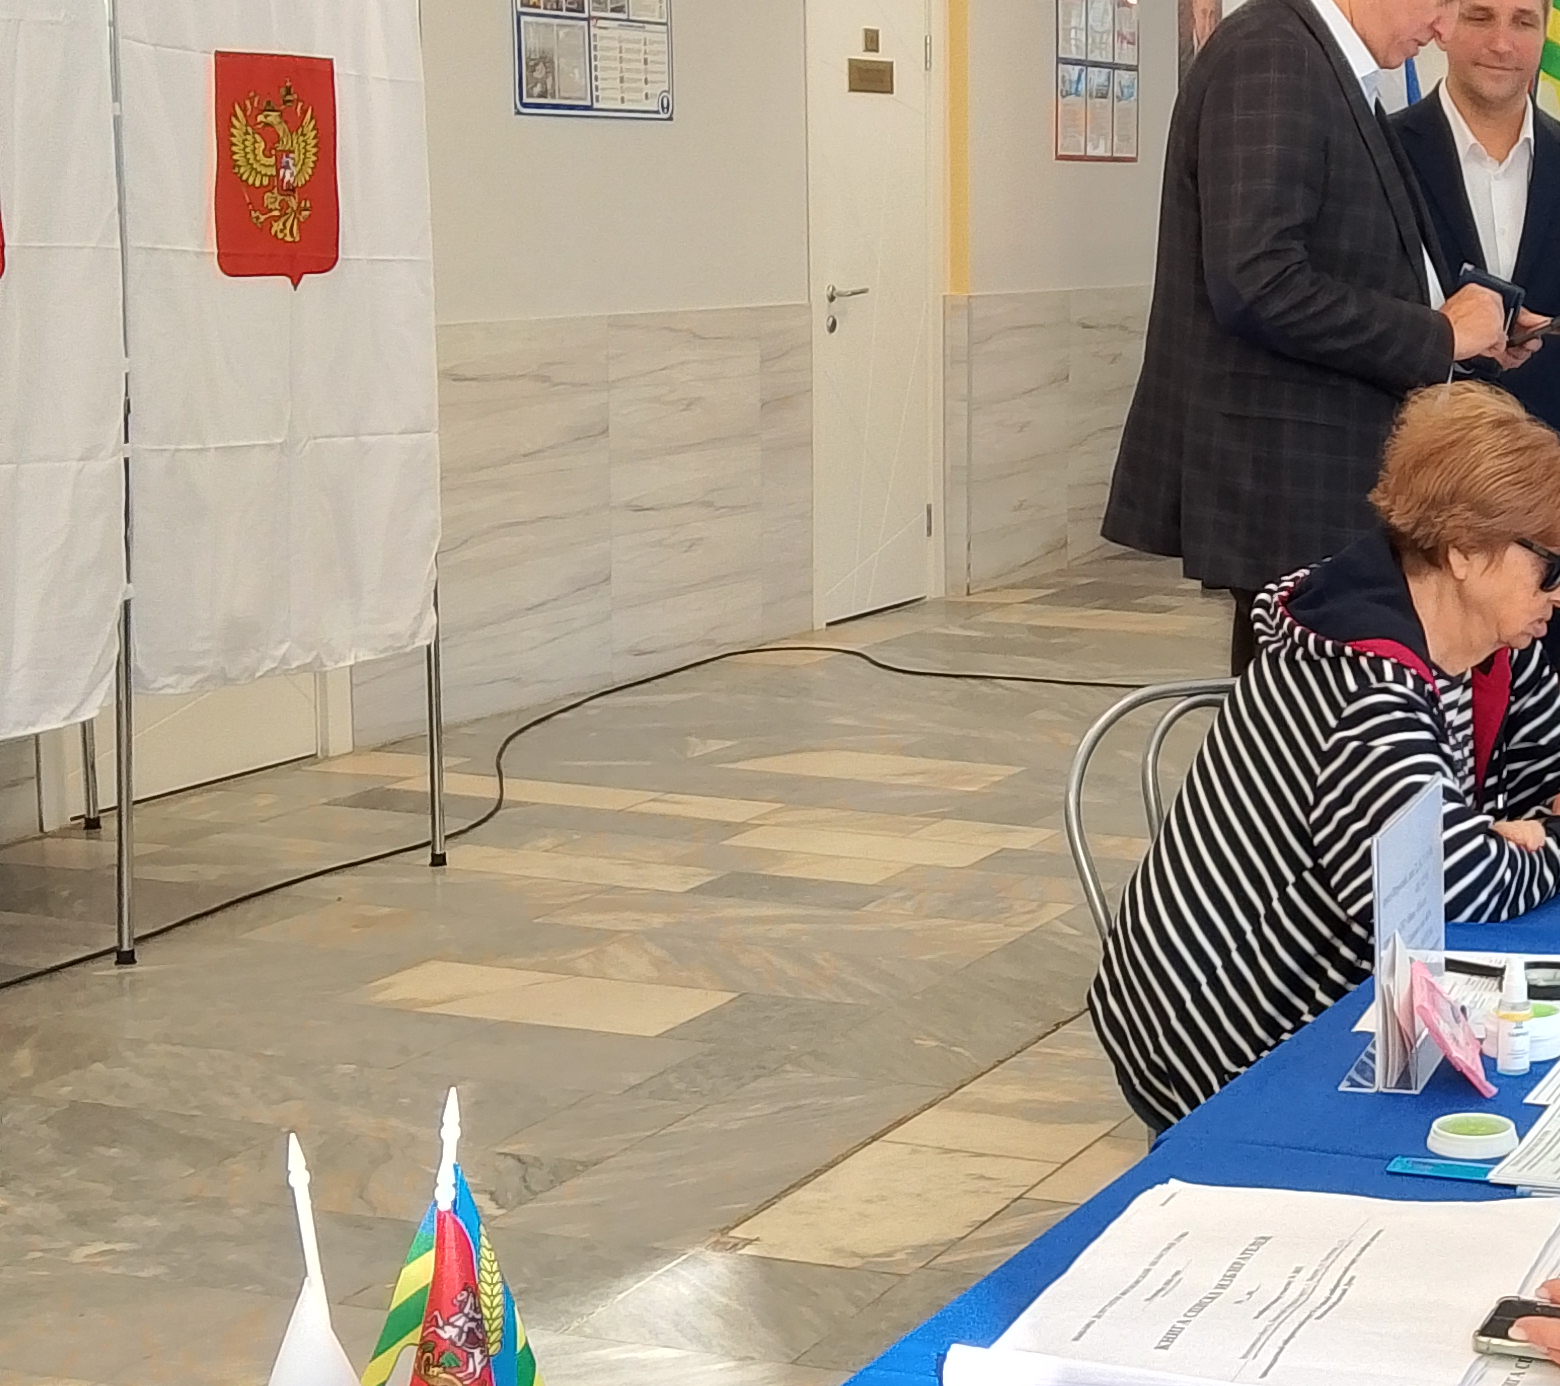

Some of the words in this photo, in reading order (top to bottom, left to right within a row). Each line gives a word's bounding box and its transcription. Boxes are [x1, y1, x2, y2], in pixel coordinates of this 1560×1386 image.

[1153, 1319, 1192, 1350] КНИГА
[1183, 1291, 1224, 1318] СПИСКА
[1214, 1235, 1275, 1291] ИЗБИРАТЕЛЕЙ
